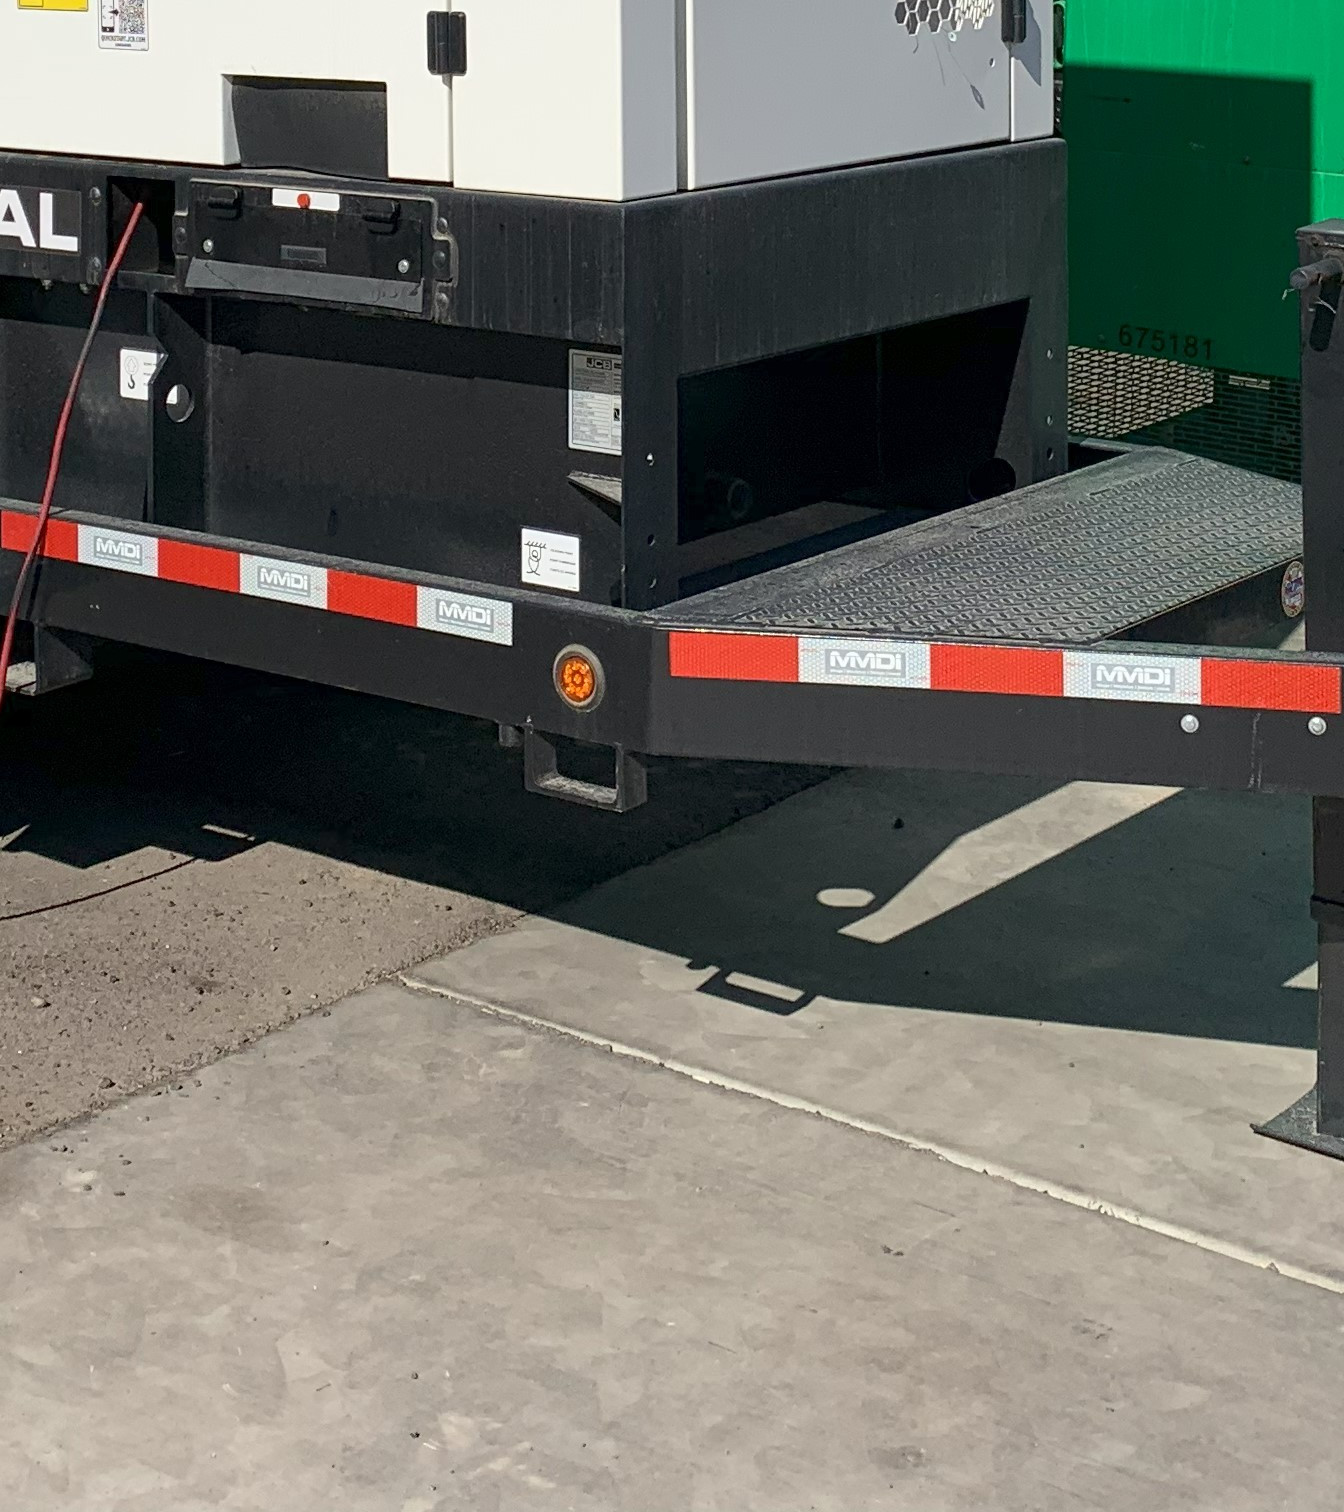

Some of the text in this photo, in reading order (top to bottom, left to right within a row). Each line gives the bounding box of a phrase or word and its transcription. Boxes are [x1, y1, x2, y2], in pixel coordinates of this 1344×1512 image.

[1118, 324, 1212, 360] 675181
[587, 358, 612, 370] JCB
[96, 537, 141, 559] MMDi
[260, 568, 308, 590] MMDi
[439, 600, 491, 625] MMDi
[830, 651, 902, 670] MMDi
[1096, 665, 1171, 685] MMDi
